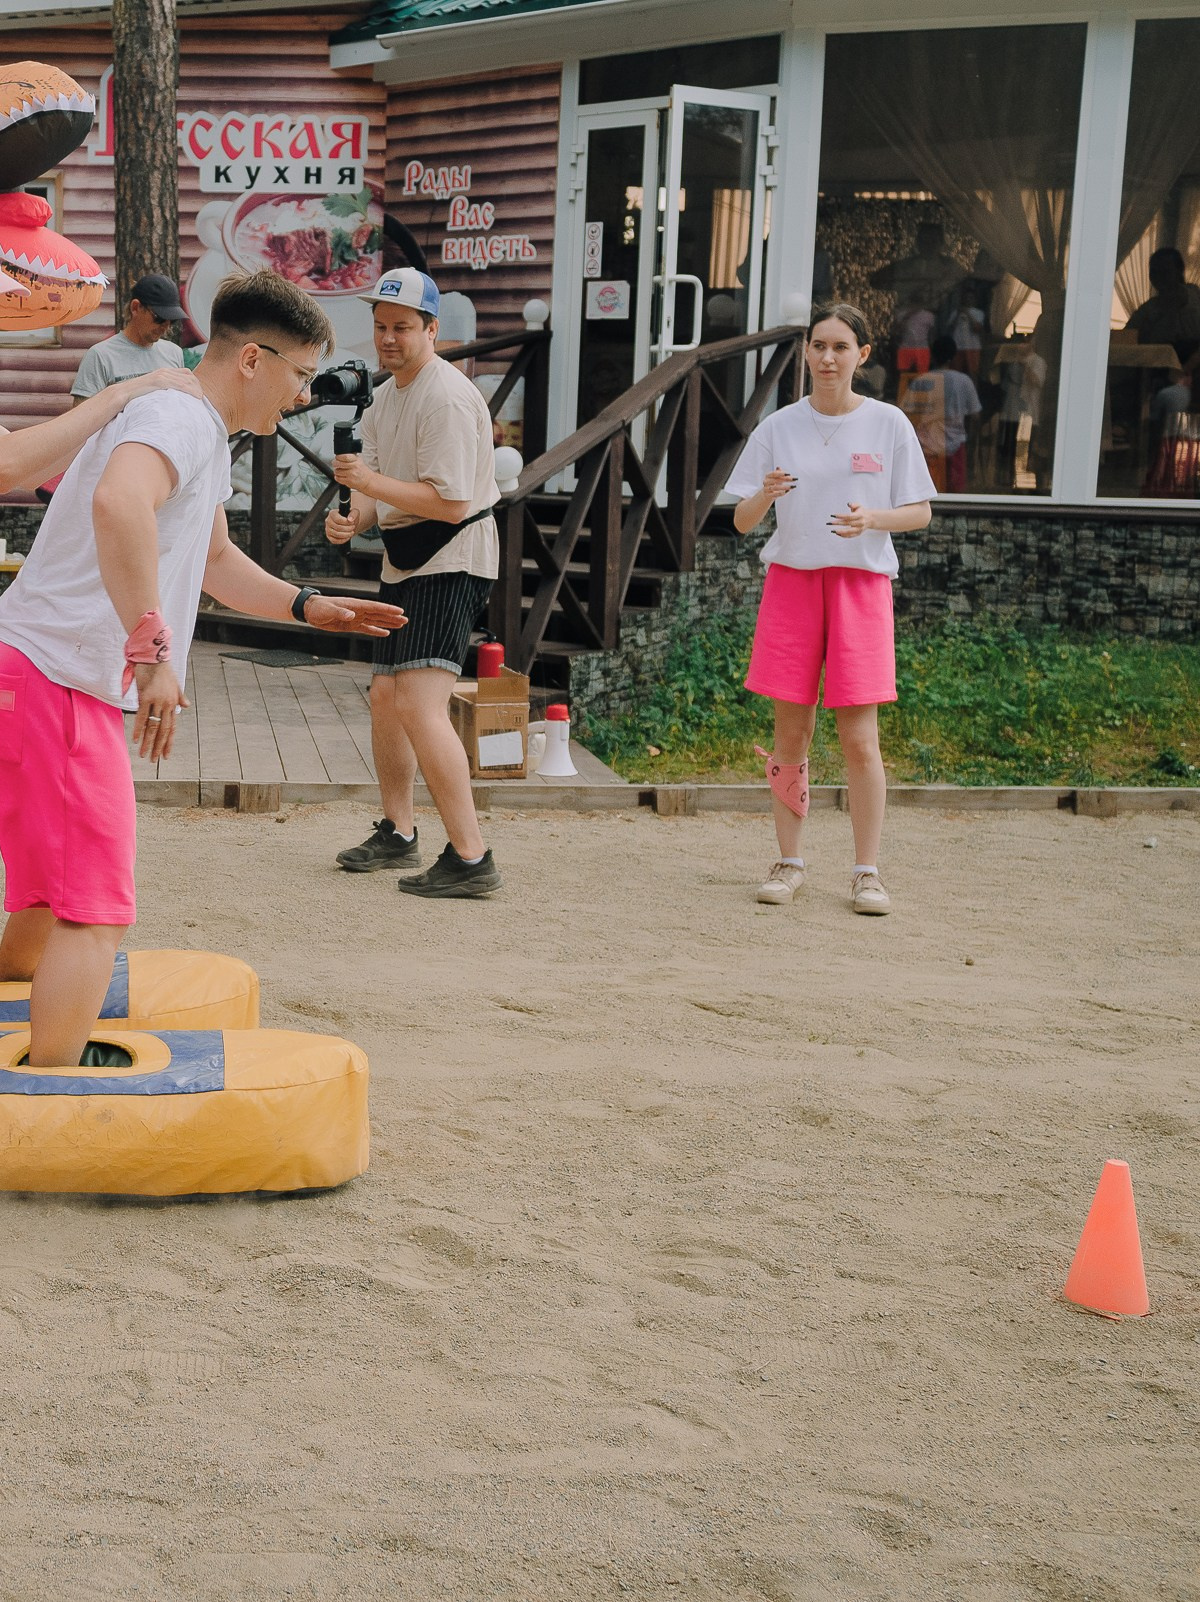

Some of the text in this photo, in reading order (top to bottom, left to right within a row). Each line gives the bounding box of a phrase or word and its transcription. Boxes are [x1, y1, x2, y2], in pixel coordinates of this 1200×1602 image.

[95, 75, 362, 160] сская
[214, 165, 356, 189] кухня
[405, 162, 471, 196] Рады
[450, 199, 494, 230] Вас
[444, 237, 536, 267] видеть
